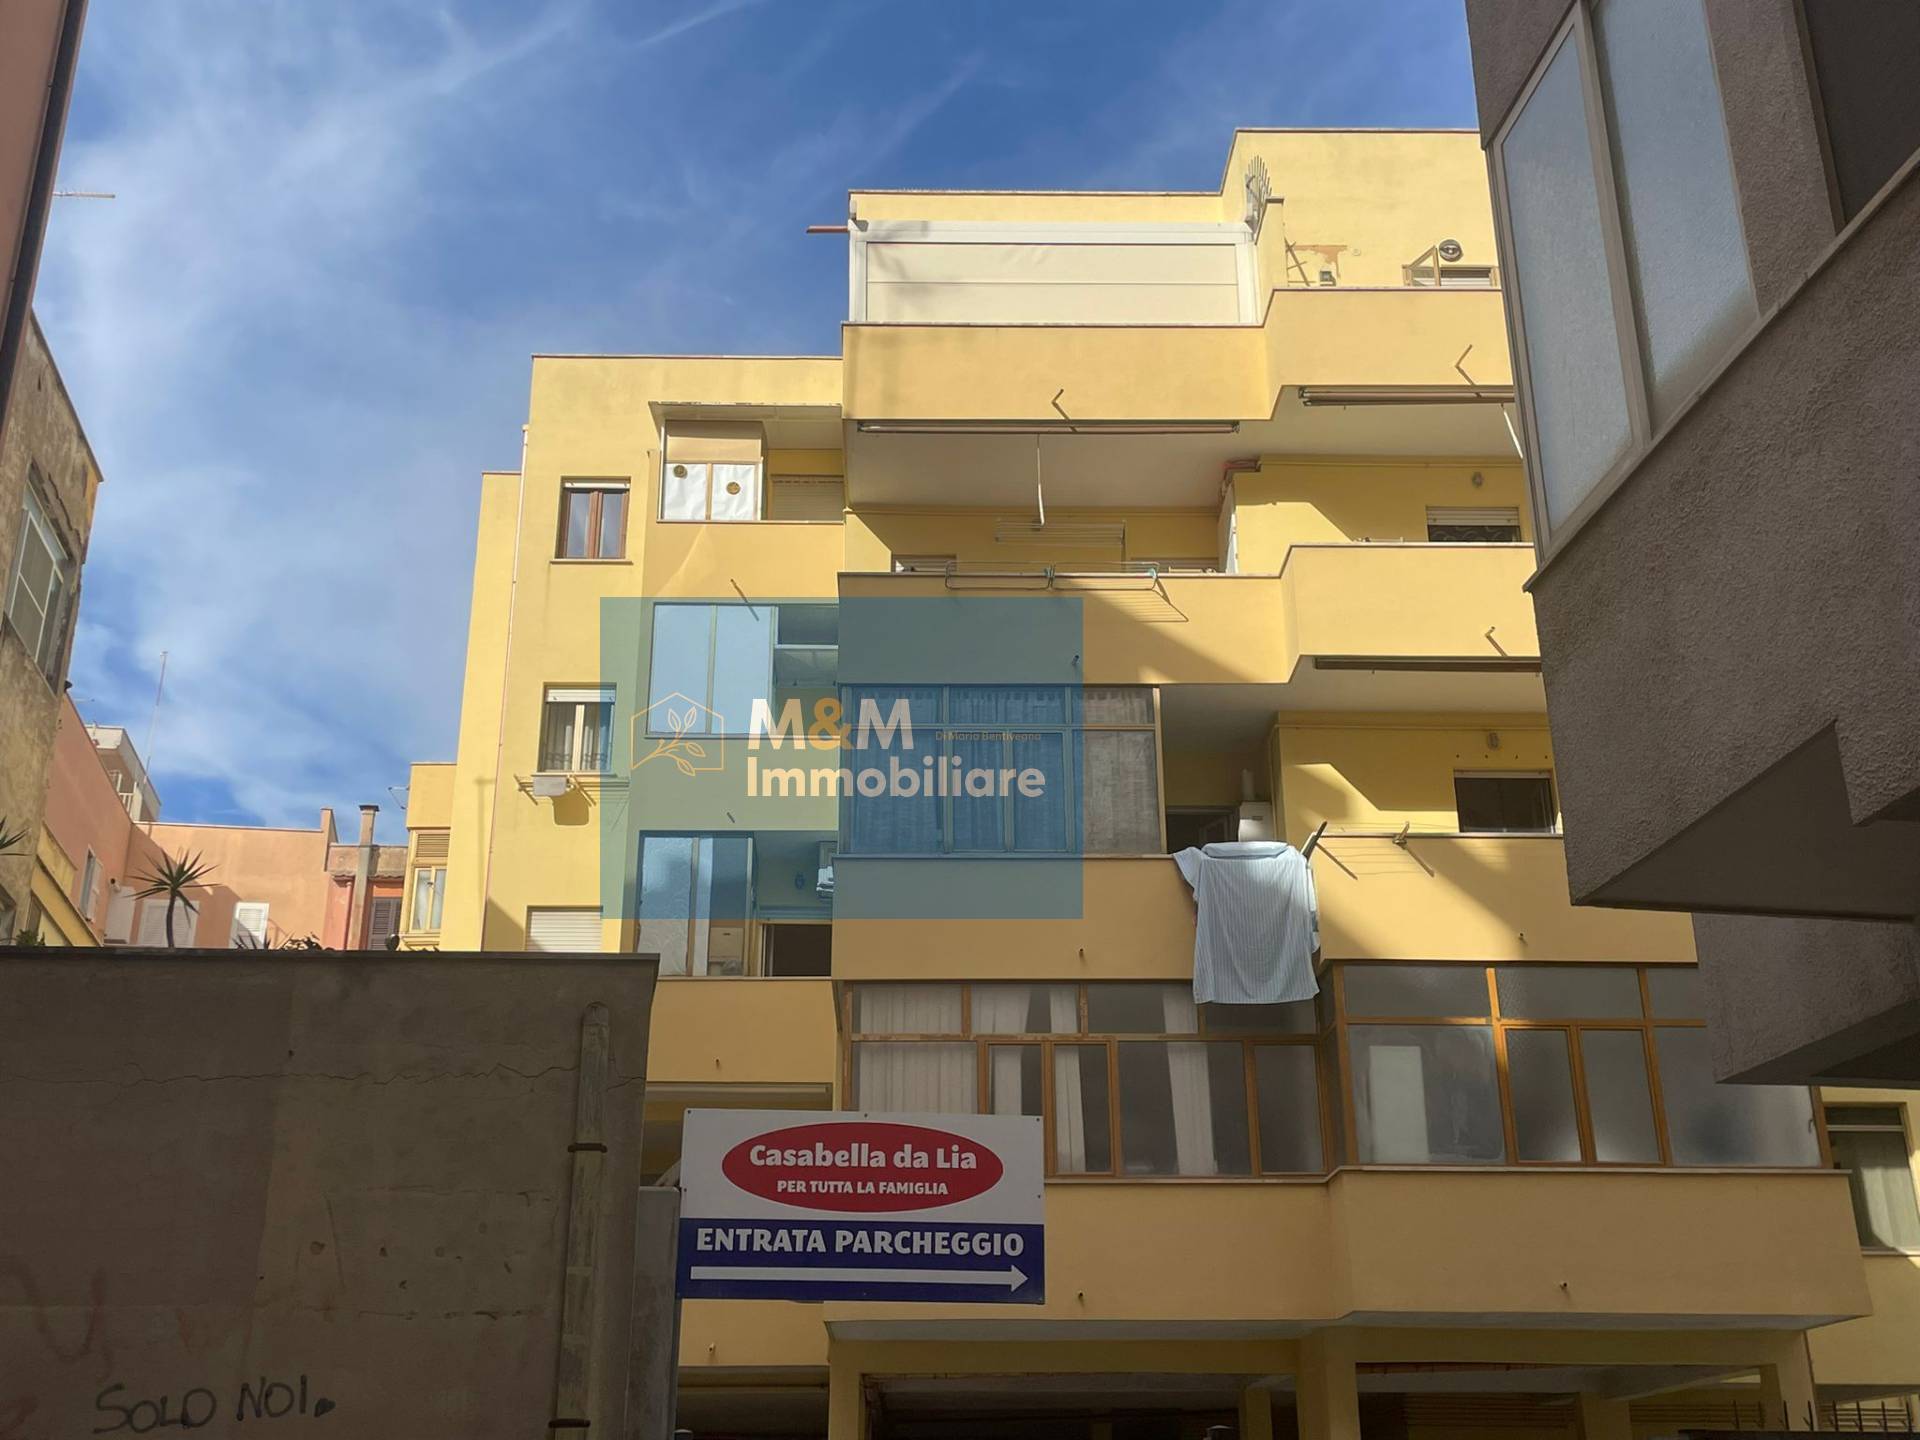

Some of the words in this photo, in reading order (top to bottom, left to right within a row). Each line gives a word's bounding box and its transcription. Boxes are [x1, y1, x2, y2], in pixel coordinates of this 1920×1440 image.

[749, 1142, 886, 1169] Casabella
[893, 1144, 929, 1168] da
[936, 1145, 977, 1169] Lia
[776, 1180, 806, 1193] PER
[810, 1181, 853, 1194] TUTTA
[857, 1181, 875, 1194] LA
[879, 1182, 948, 1196] FAMIGLIA
[696, 1227, 826, 1253] ENTRATA
[834, 1230, 1024, 1257] PARCHEGGIO
[93, 1382, 217, 1434] SOLO
